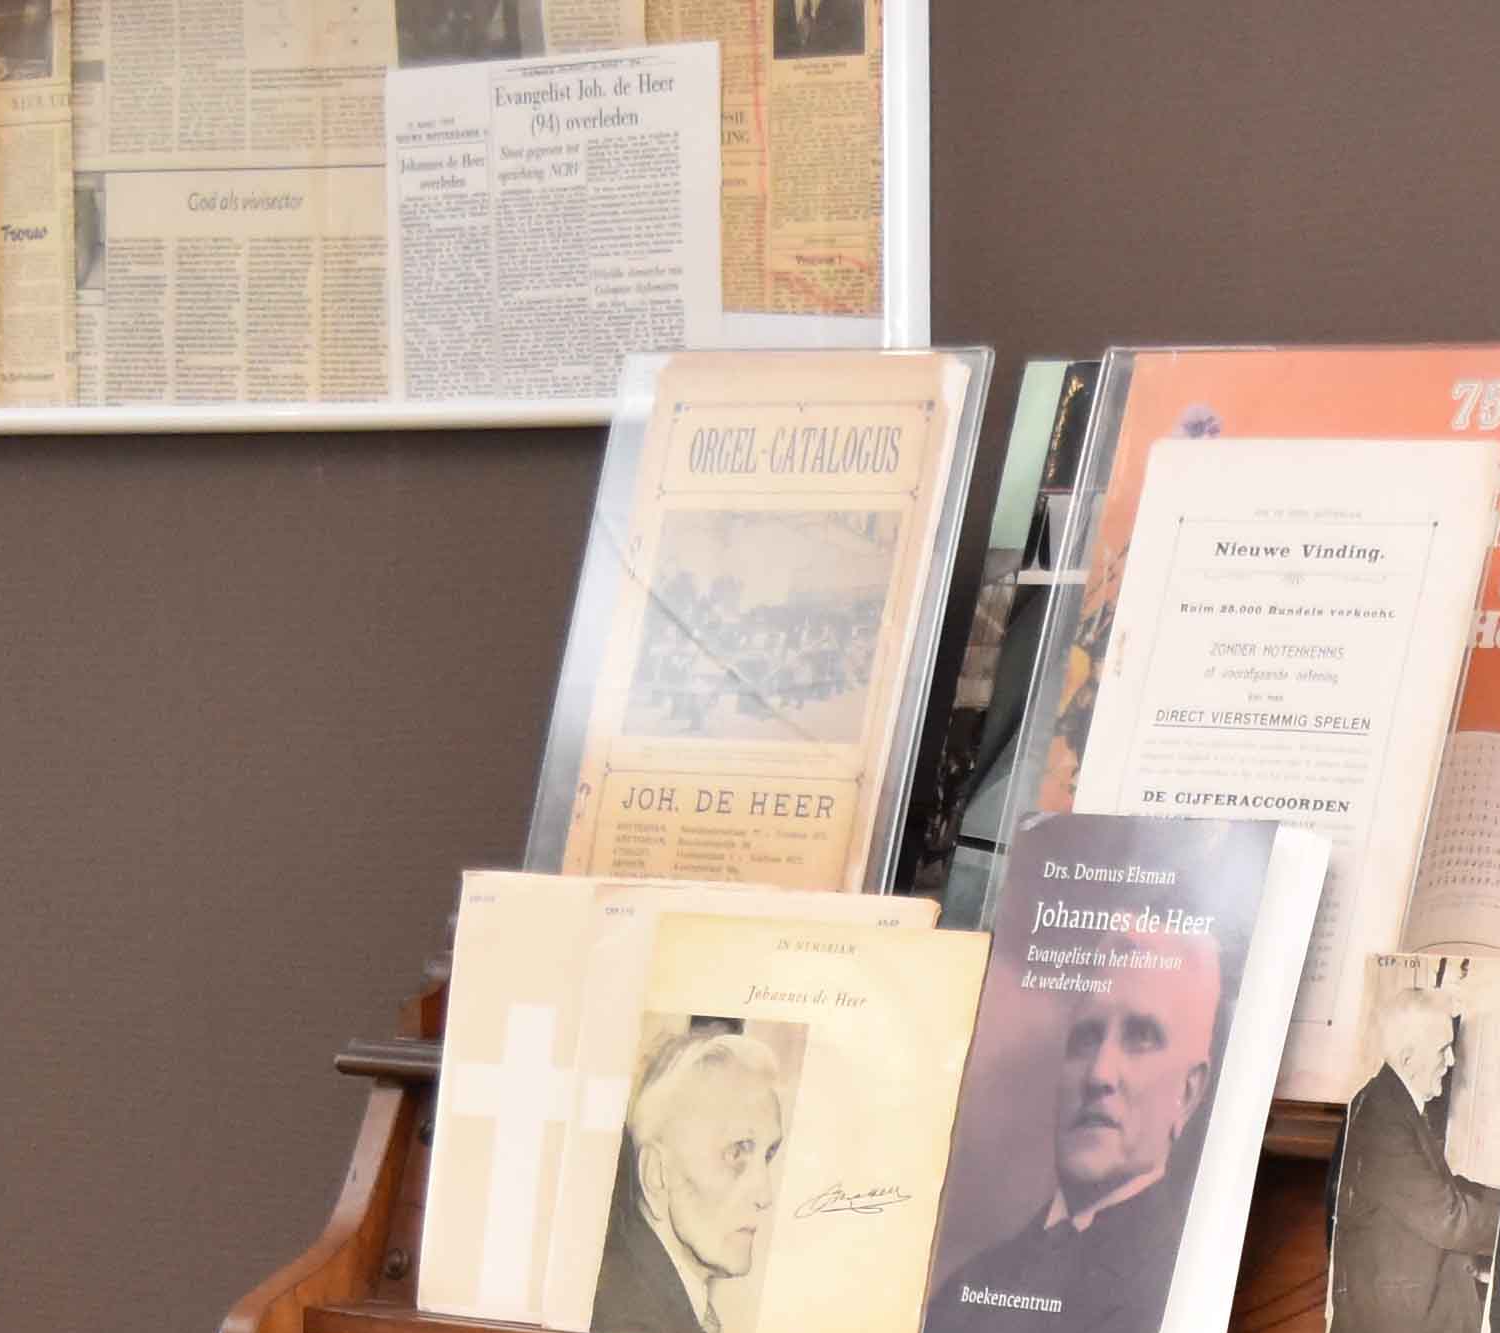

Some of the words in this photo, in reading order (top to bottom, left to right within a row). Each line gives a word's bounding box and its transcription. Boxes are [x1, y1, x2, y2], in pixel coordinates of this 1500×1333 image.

[495, 81, 571, 110] Evangelist
[579, 79, 606, 101] Joh.
[614, 75, 631, 95] de
[639, 72, 674, 94] Heer
[531, 113, 561, 137] (94)
[566, 110, 639, 131] overleden
[462, 153, 485, 168] Heer
[187, 191, 218, 212] God
[220, 187, 239, 211] als
[242, 191, 304, 211] vivisector
[1214, 541, 1291, 559] Nieuwe
[1301, 543, 1386, 564] Vinding.
[1268, 605, 1324, 617] Bundels
[1209, 643, 1257, 658] ZONDER
[1155, 709, 1205, 723] DIRECT
[1211, 711, 1308, 728] VIERSTEMMIG
[1313, 715, 1371, 730] SPELEN
[621, 786, 680, 814] JOH.
[695, 789, 735, 814] DE
[749, 790, 836, 819] HEER
[1142, 790, 1167, 803] DE
[1175, 792, 1351, 813] CIJFERACCOORDEN
[1043, 861, 1071, 880] Drs.
[1074, 863, 1125, 883] Domus
[1125, 865, 1177, 885] Elsman
[1031, 899, 1131, 935] Johannes
[1135, 905, 1161, 935] de
[1164, 908, 1216, 936] Heer
[778, 938, 790, 950] IN
[794, 940, 857, 955] MEMORIAM
[1027, 944, 1092, 969] Evangelist
[1093, 948, 1107, 967] in
[1108, 948, 1129, 968] het
[1130, 950, 1159, 969] licht
[1158, 956, 1184, 971] van
[1021, 970, 1038, 989] de
[1038, 972, 1114, 994] wederkomst
[744, 984, 809, 1005] Johannes
[812, 989, 827, 1006] de
[835, 991, 868, 1008] Heer
[961, 1285, 1063, 1314] Boekencentrum
